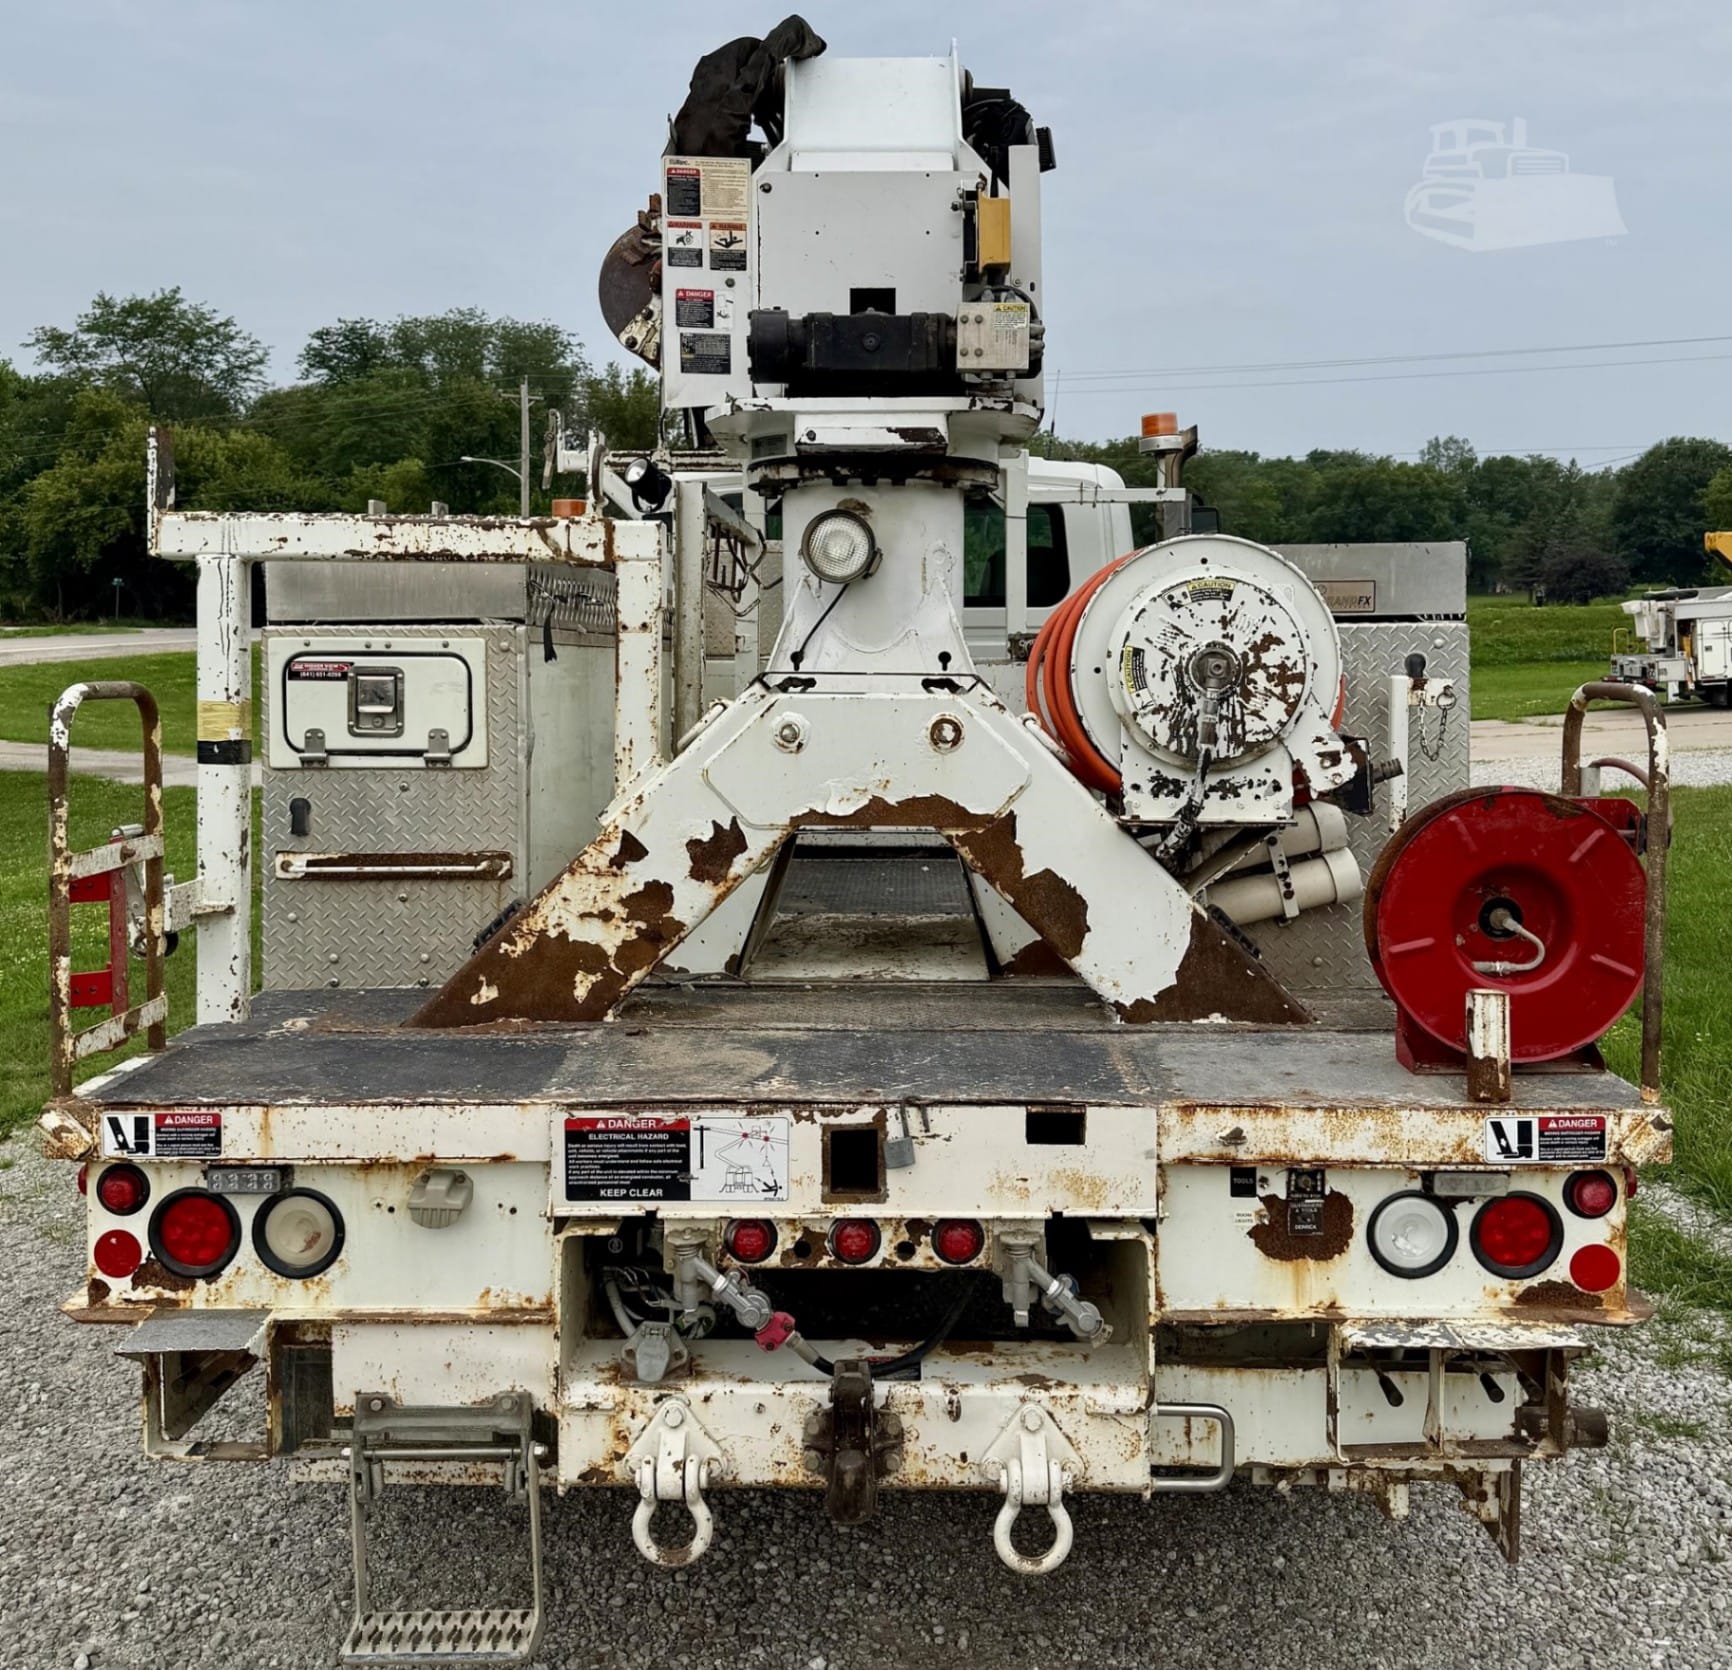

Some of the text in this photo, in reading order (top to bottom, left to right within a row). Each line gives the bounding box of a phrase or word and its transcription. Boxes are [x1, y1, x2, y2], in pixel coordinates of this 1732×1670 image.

[175, 1116, 213, 1124] DANGER
[608, 1119, 656, 1128] DANGER
[1559, 1119, 1597, 1128] DANGER
[628, 1189, 663, 1197] CLEAR
